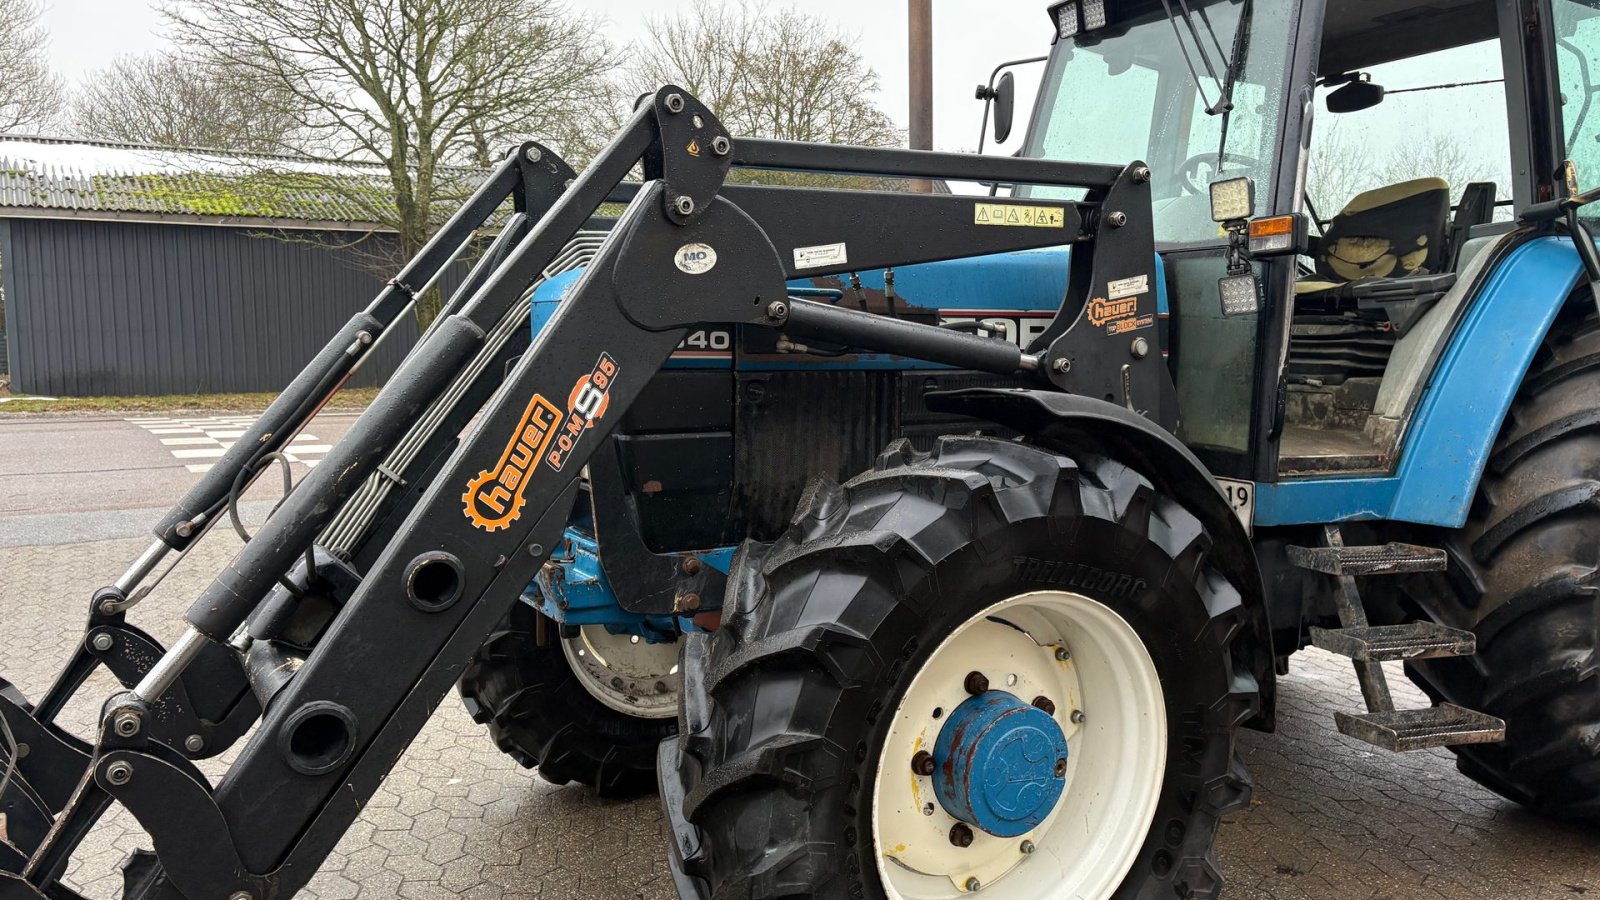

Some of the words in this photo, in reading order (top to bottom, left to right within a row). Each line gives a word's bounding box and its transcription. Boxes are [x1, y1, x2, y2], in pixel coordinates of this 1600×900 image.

[683, 251, 707, 261] MO
[1095, 302, 1134, 319] hauer
[677, 330, 730, 350] 40
[477, 406, 548, 515] hauer
